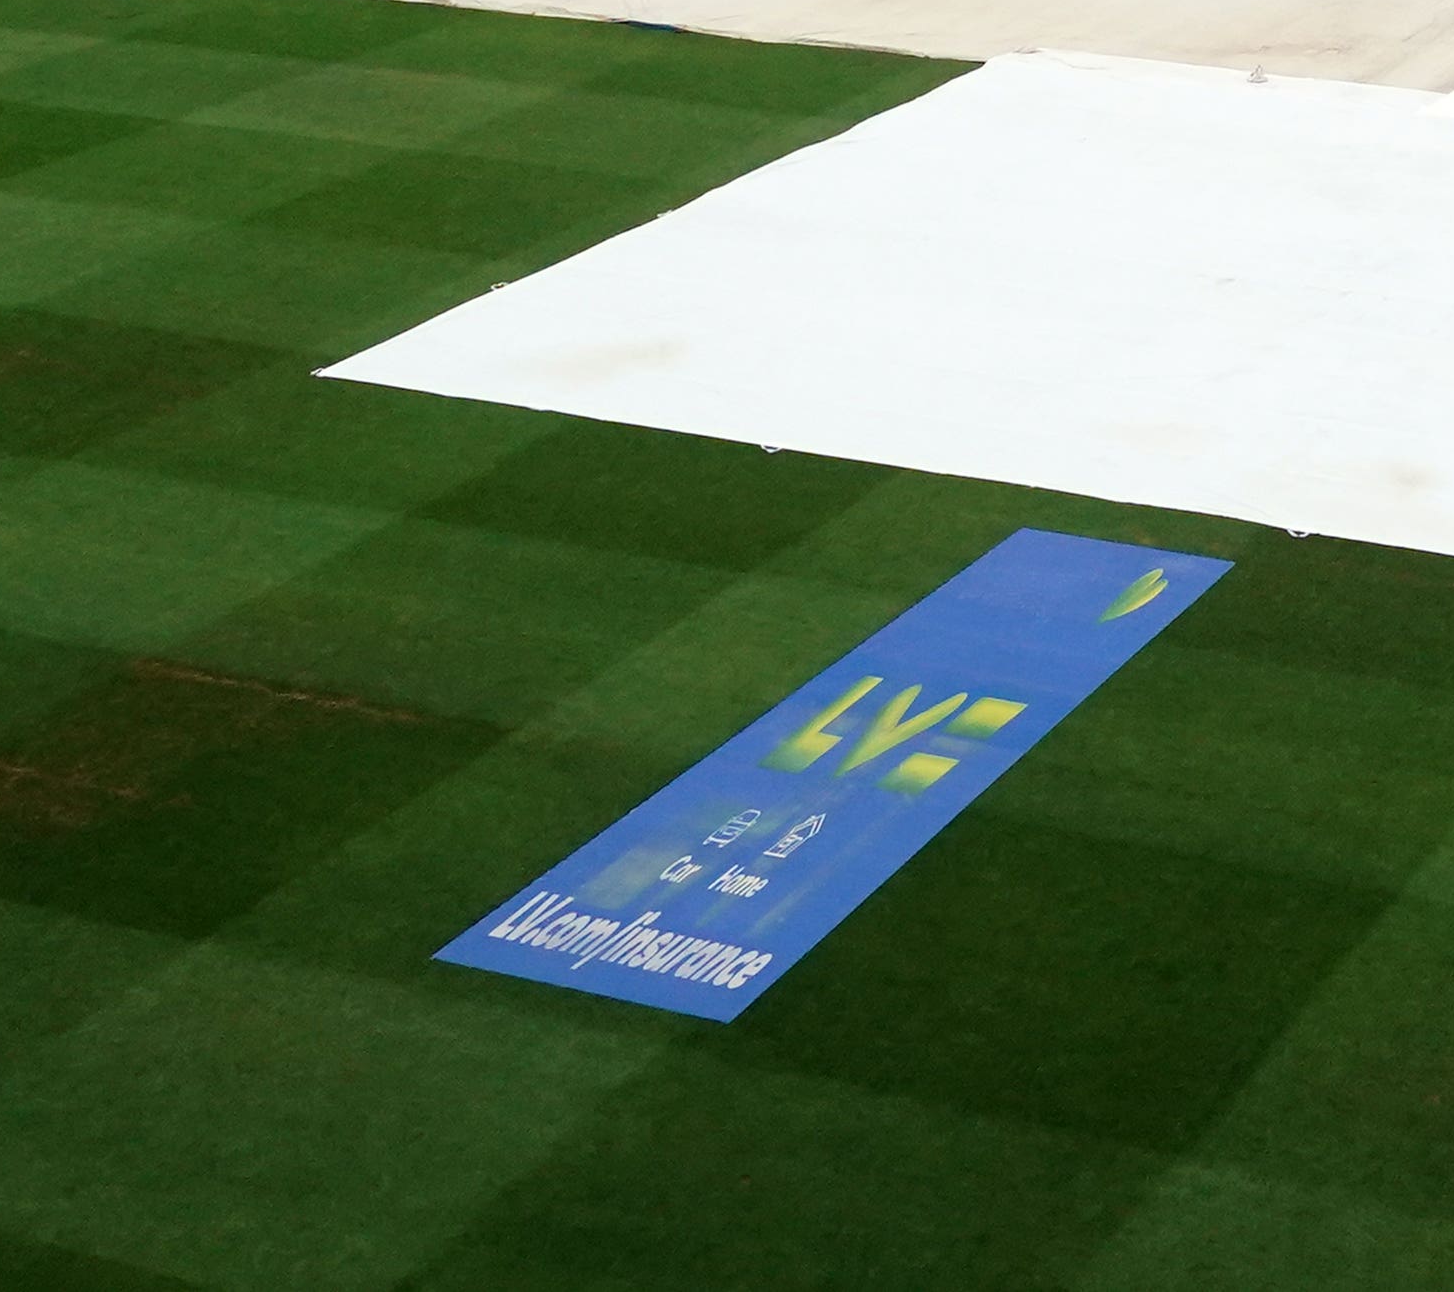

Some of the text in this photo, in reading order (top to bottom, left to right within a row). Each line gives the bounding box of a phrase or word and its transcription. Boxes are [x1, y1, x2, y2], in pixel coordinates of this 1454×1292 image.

[659, 855, 769, 898] Car Home
[488, 891, 773, 989] LV.com/insurance
